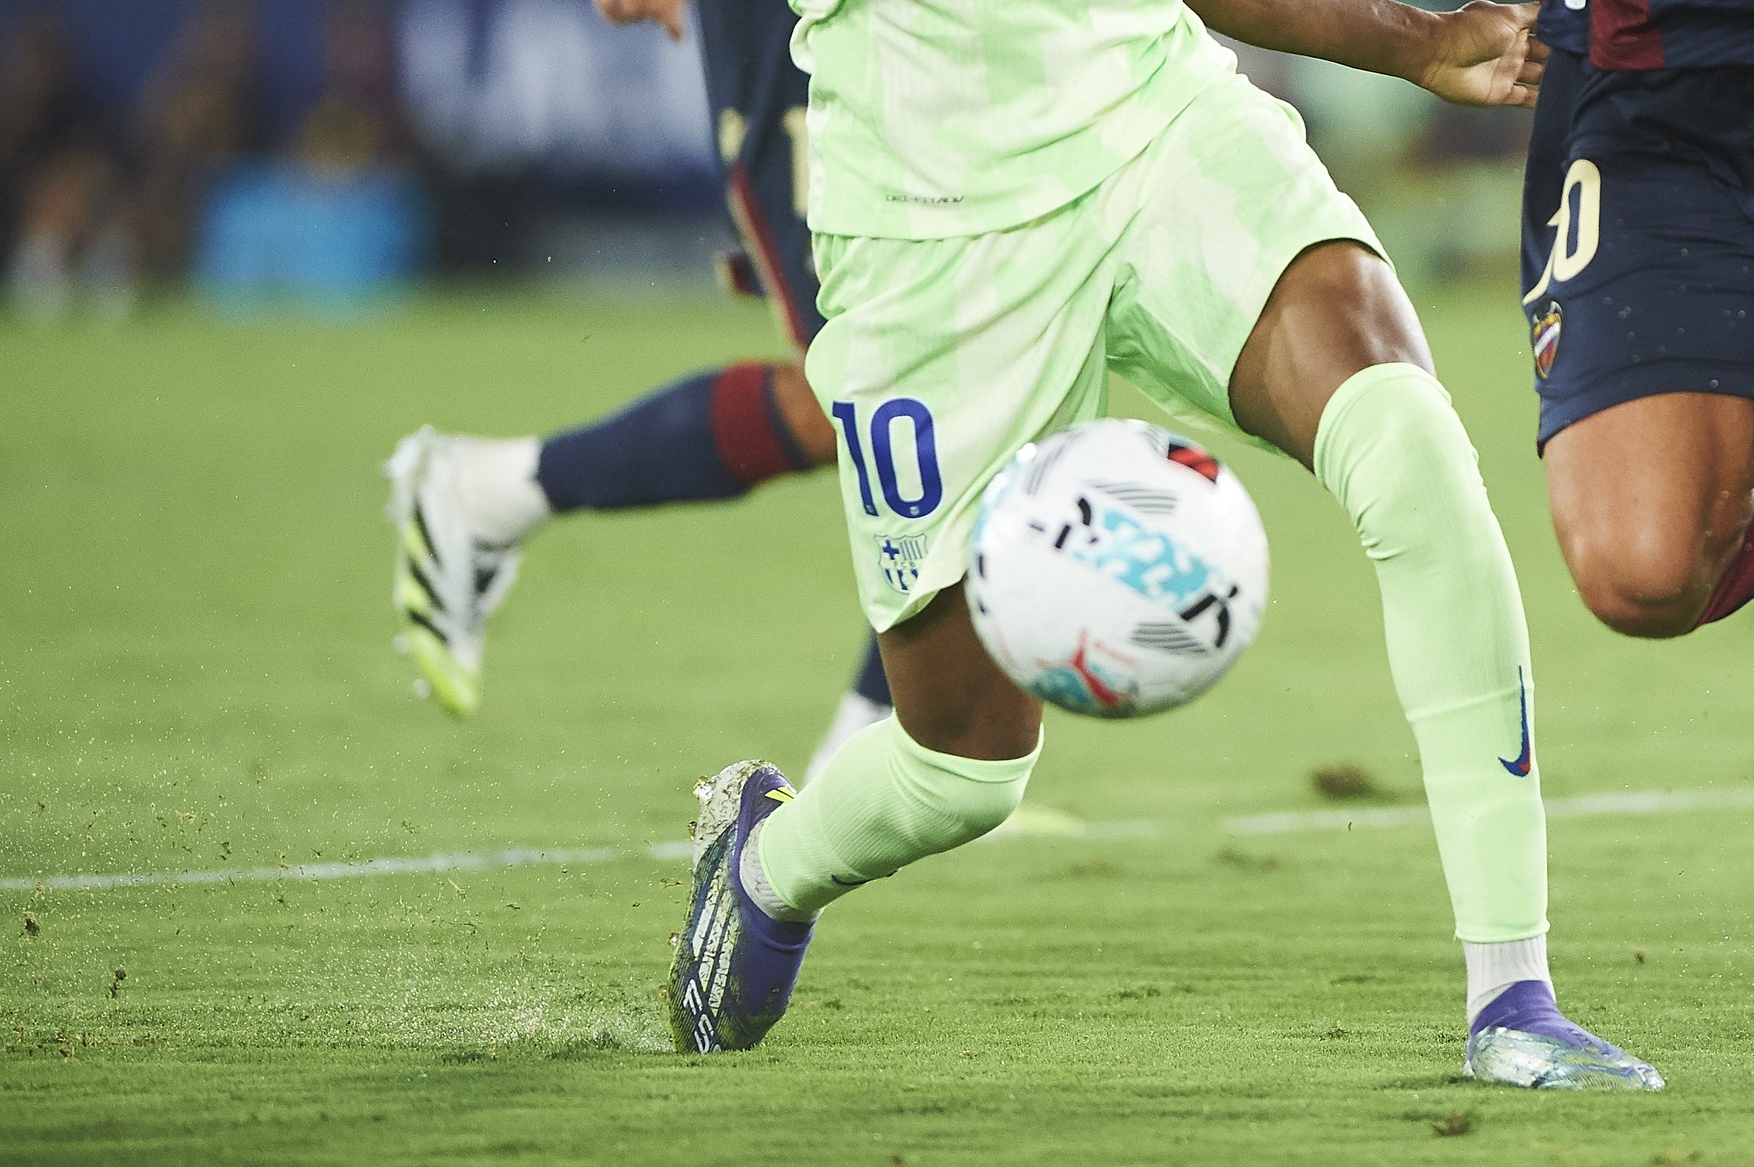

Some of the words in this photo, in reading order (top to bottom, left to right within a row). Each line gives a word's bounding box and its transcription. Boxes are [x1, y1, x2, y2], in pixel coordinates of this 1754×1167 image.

[1522, 158, 1601, 306] 0
[831, 397, 944, 519] 10
[681, 978, 722, 1055] F5
